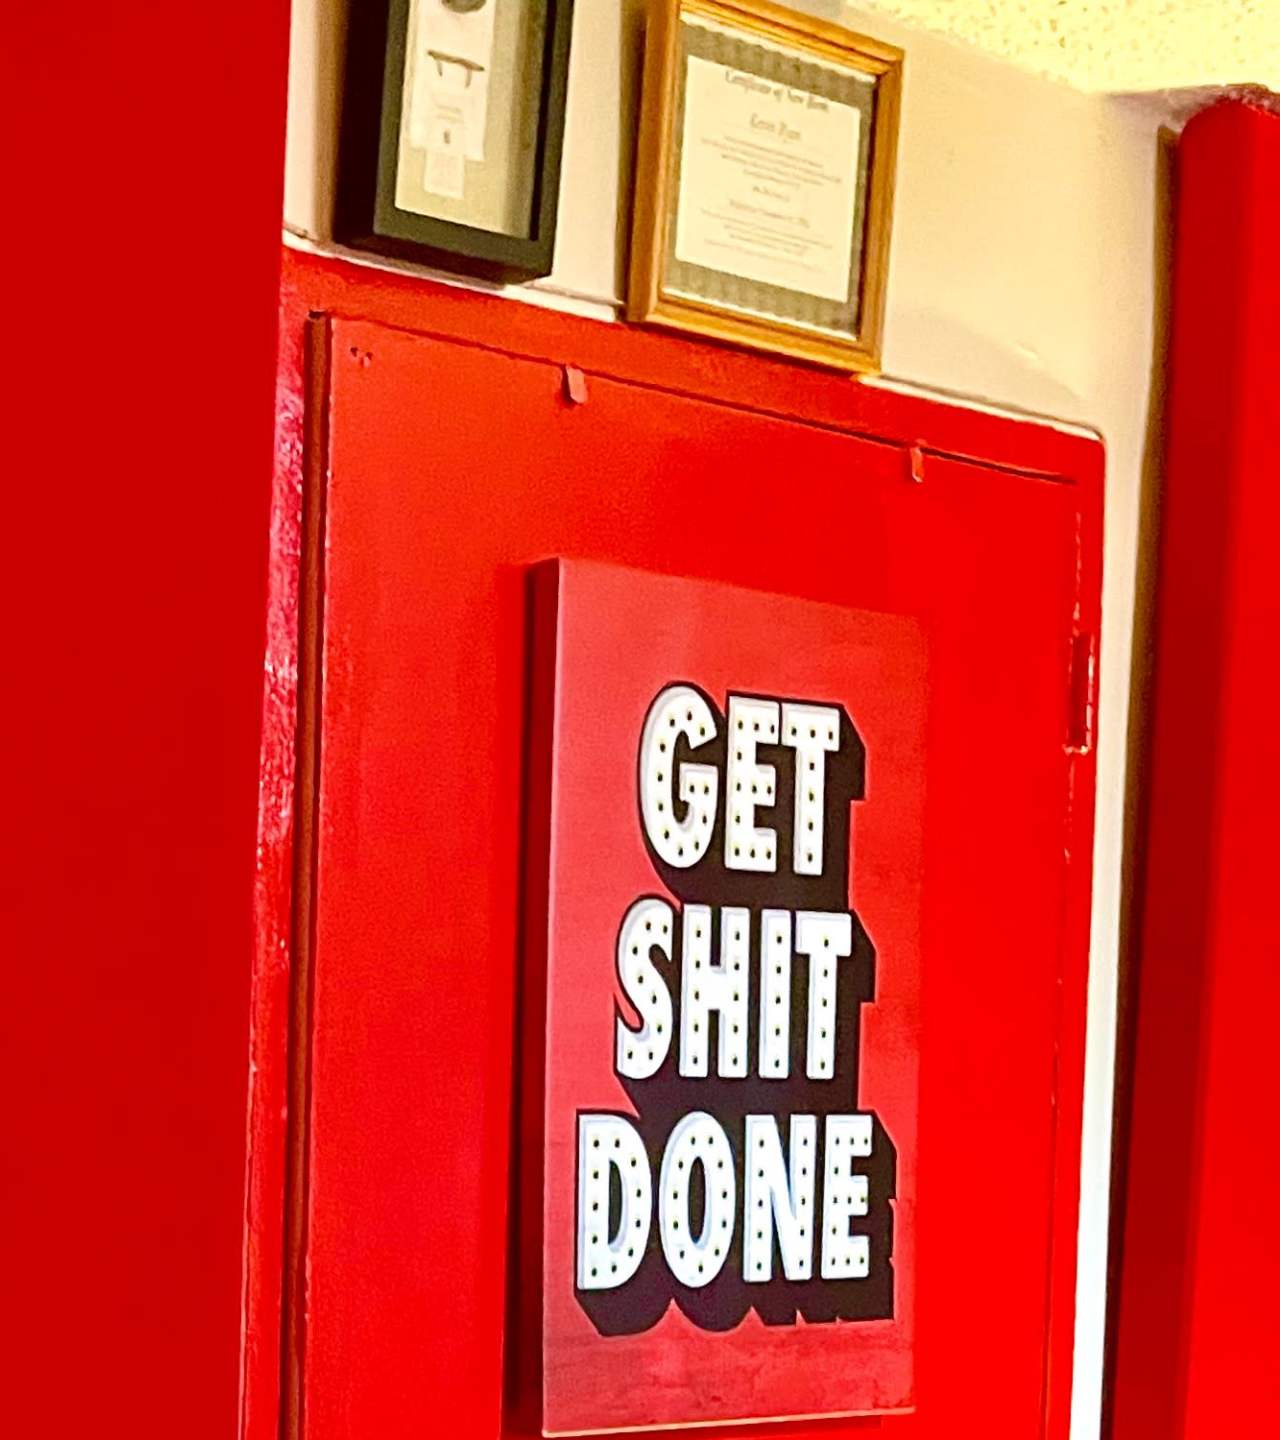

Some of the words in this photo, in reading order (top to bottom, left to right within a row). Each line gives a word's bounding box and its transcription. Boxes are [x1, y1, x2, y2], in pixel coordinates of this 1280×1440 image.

[641, 685, 840, 876] GET
[616, 896, 852, 1081] SHIT
[576, 1111, 874, 1291] DONE
